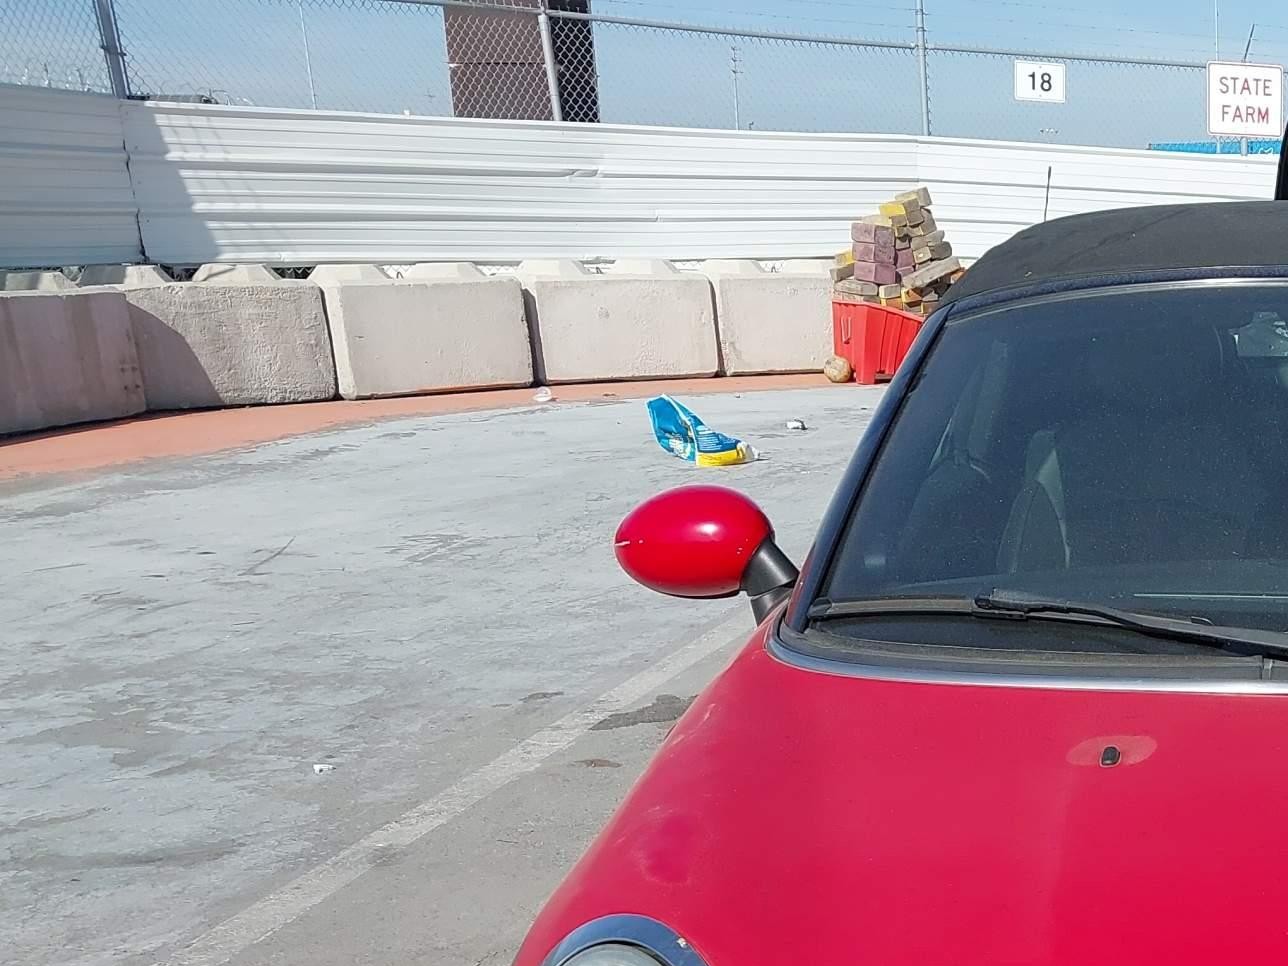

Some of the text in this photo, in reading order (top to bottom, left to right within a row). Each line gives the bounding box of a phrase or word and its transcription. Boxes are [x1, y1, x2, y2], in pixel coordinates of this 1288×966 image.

[1027, 71, 1053, 92] 18
[1219, 76, 1272, 97] STATE
[1221, 104, 1270, 125] FARM
